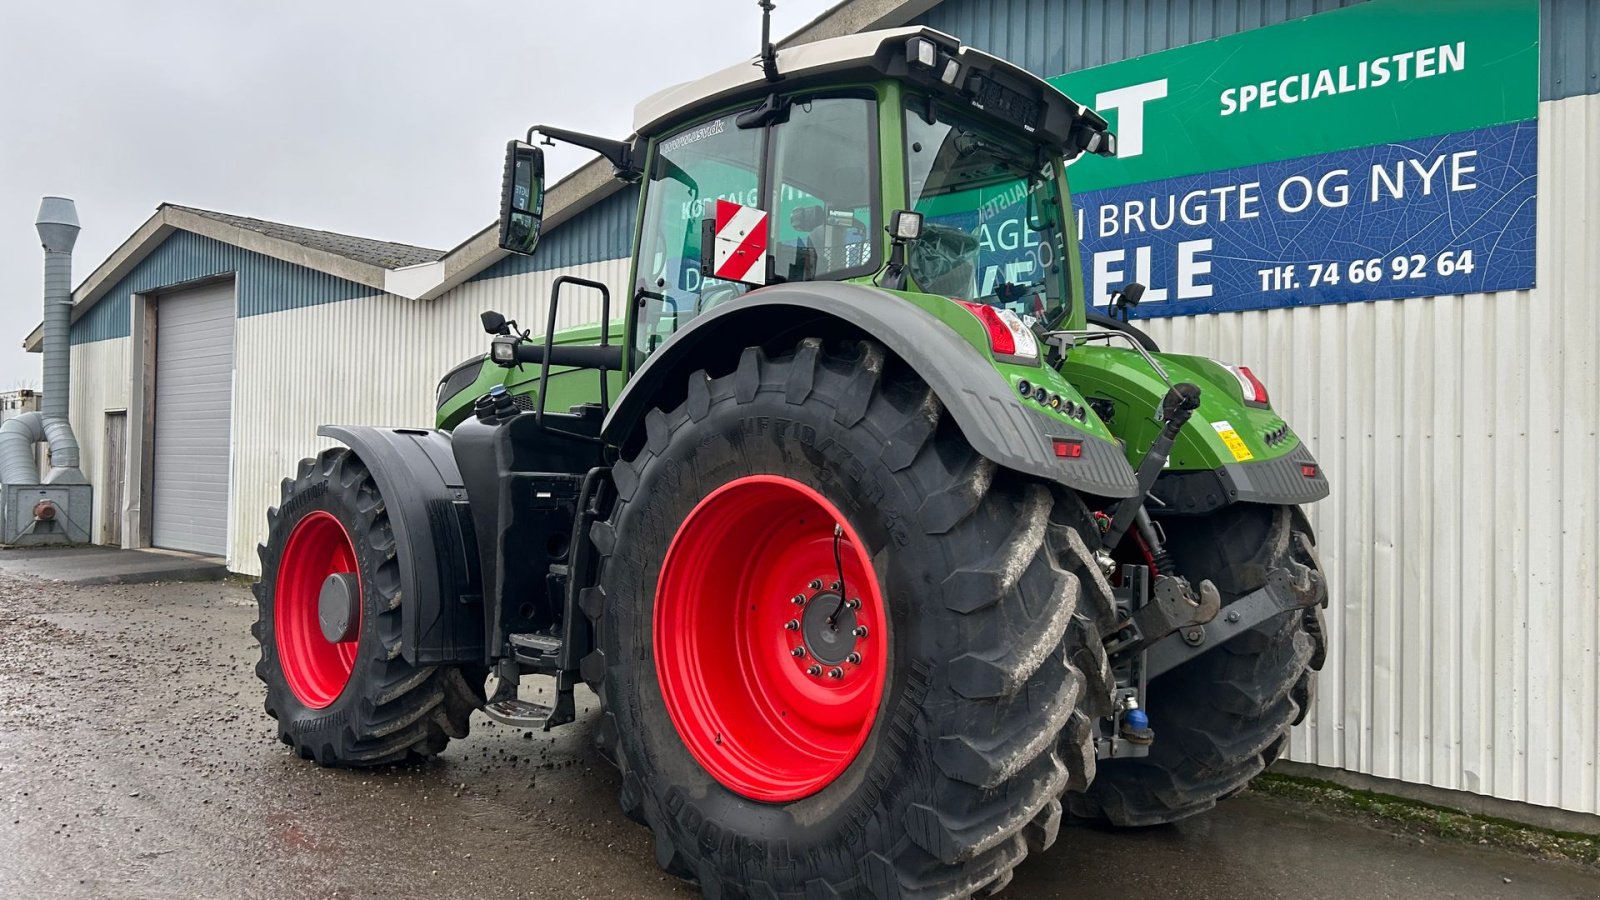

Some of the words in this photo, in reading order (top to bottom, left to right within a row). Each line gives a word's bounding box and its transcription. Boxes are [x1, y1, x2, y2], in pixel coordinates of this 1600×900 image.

[1220, 41, 1466, 116] SPECIALISTEN
[1096, 78, 1168, 159] T
[979, 215, 1039, 252] AGE
[1100, 182, 1260, 238] BRUGTE
[1277, 169, 1349, 213] OG
[1371, 150, 1478, 203] NYE
[1093, 238, 1214, 307] ELE
[1258, 265, 1300, 291] Tlf.
[1308, 262, 1340, 287] 74
[1348, 258, 1382, 283] 66
[1392, 254, 1427, 280] 92
[1436, 250, 1475, 276] 64
